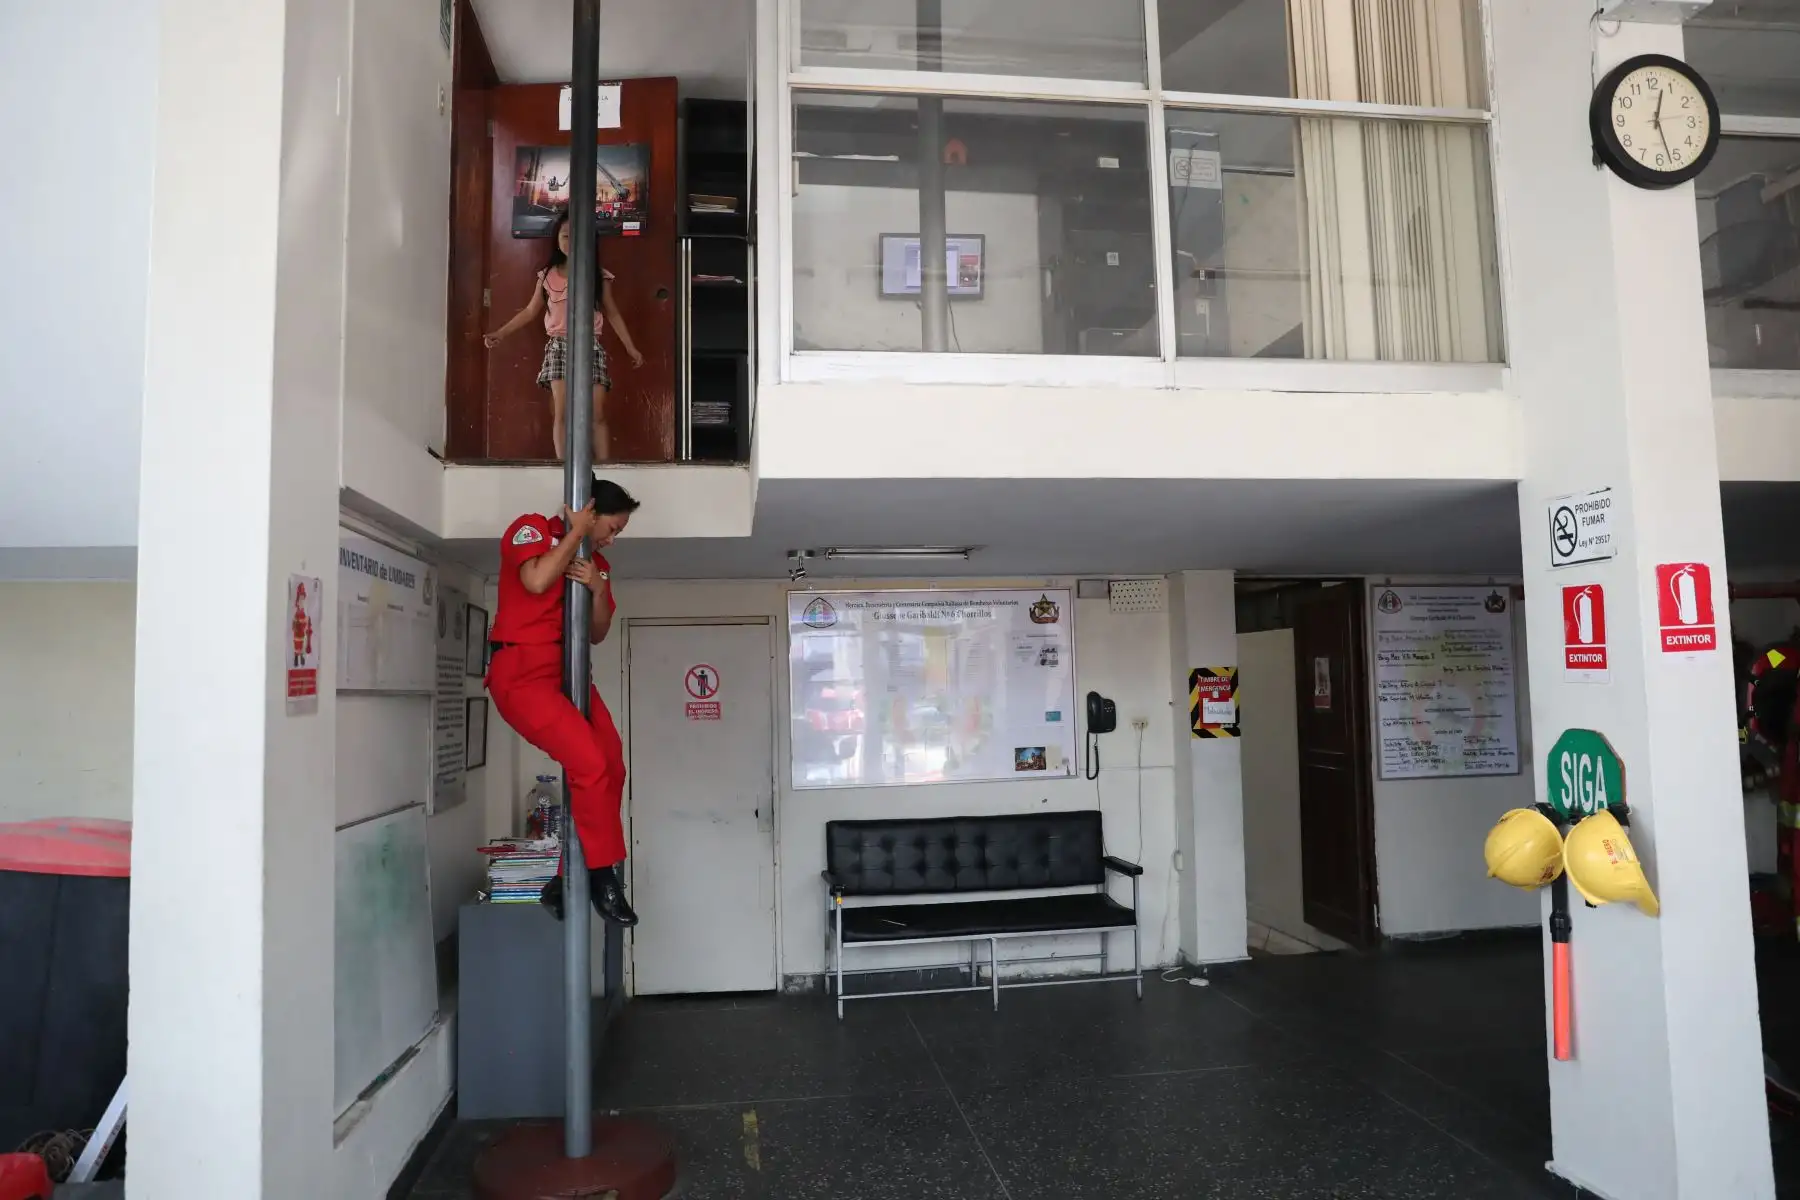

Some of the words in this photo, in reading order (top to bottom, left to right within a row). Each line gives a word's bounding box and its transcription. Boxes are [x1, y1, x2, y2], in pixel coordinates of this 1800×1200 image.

[1630, 83, 1641, 95] 11
[1646, 77, 1658, 90] 12
[1668, 83, 1673, 94] 1
[1618, 96, 1632, 109] 10
[1681, 96, 1690, 109] 2
[1616, 114, 1625, 128] 9
[1687, 116, 1696, 128] 3
[1622, 134, 1632, 147] 8
[1684, 135, 1693, 148] 4
[1638, 148, 1647, 160] 7
[1655, 153, 1664, 167] 6
[1672, 148, 1681, 161] 5
[1574, 497, 1611, 515] PROHIBIDO
[1581, 513, 1605, 527] FUMAR
[1578, 538, 1588, 549] Ley
[1595, 534, 1611, 545] 29517
[1665, 633, 1712, 646] EXTINTOR
[1568, 653, 1603, 664] EXTINTOR
[1560, 751, 1608, 812] SIGA
